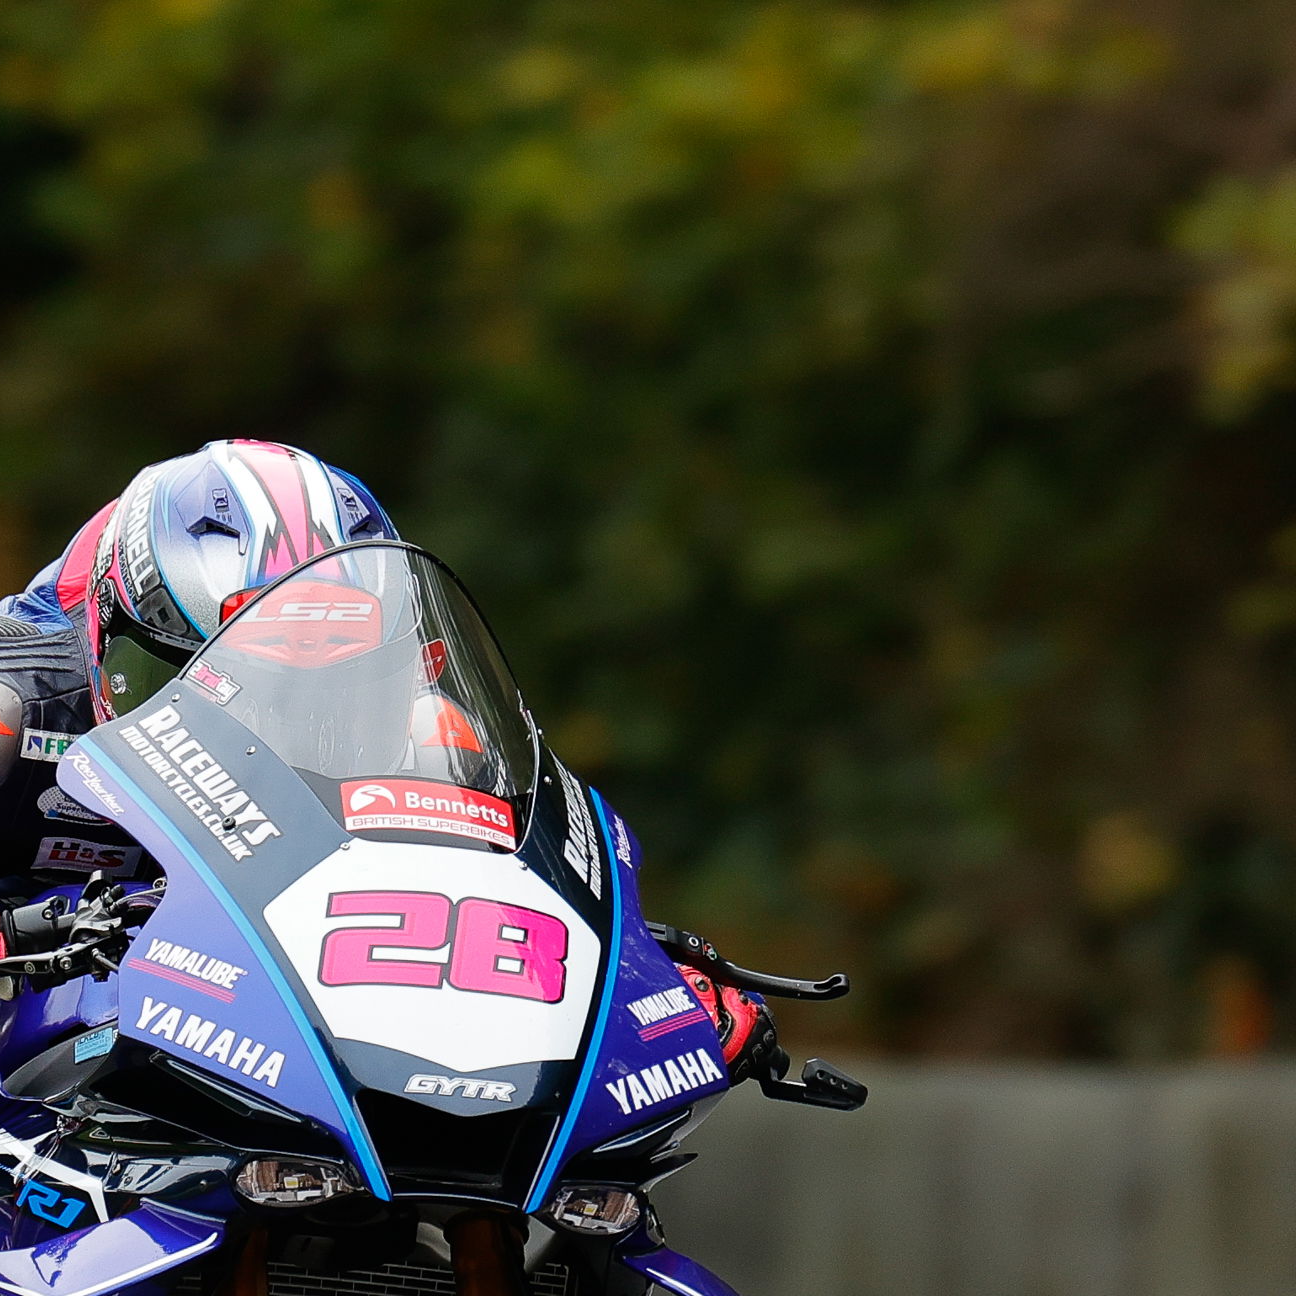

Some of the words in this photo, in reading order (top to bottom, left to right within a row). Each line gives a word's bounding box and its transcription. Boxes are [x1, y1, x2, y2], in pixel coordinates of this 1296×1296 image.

[238, 601, 373, 623] LS2
[118, 725, 253, 862] MOTORCYCLES.CO.UK
[138, 704, 282, 846] RACEWAYS
[352, 817, 414, 827] BRITISH
[417, 818, 510, 845] SUPERBIKES
[405, 791, 509, 828] Bennetts
[144, 938, 244, 990] YAMALUBE
[319, 890, 568, 1003] 28
[626, 986, 697, 1026] YAMALUBE
[135, 995, 286, 1088] YAMAHA
[404, 1073, 514, 1103] GYTR
[605, 1048, 724, 1115] YAMAHA
[15, 1179, 86, 1228] R1
